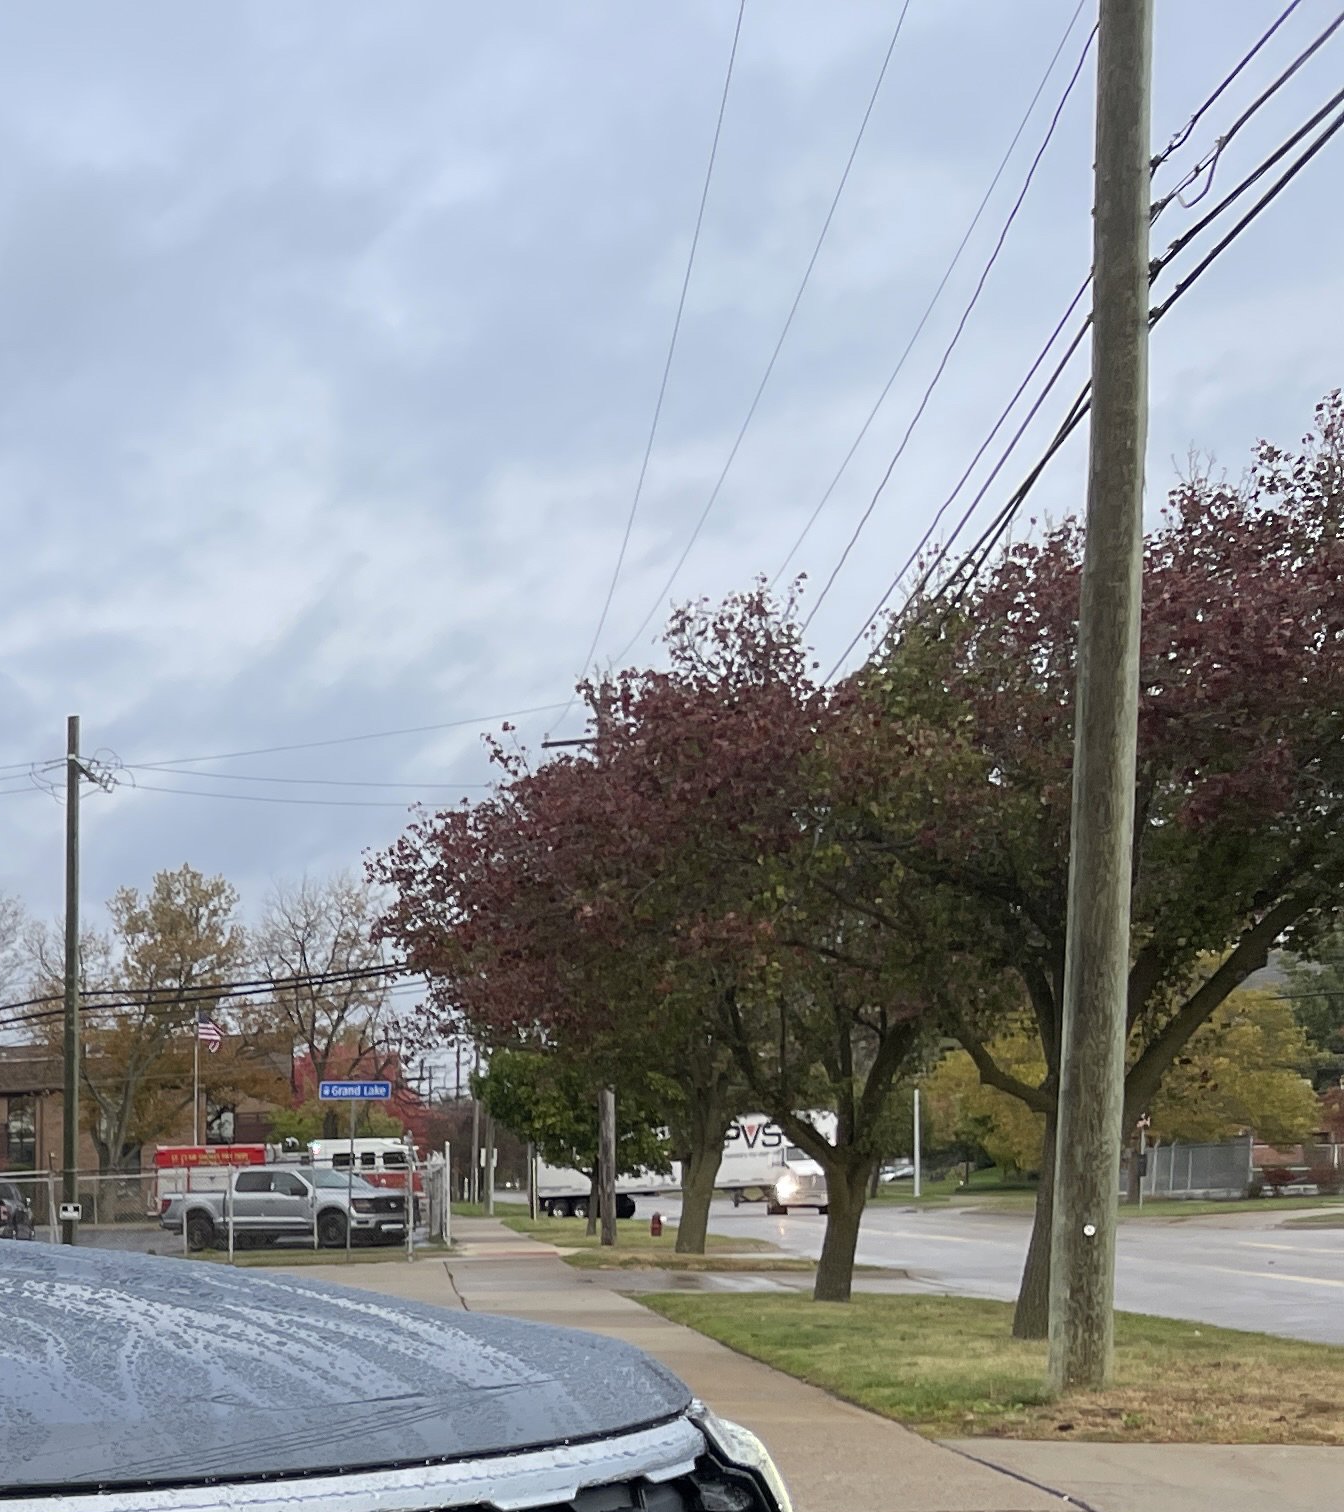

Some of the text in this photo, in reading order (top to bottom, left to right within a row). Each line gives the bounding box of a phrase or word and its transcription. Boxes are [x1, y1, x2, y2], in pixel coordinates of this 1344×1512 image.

[331, 1084, 387, 1097] Grand Lake
[723, 1121, 783, 1148] PVS
